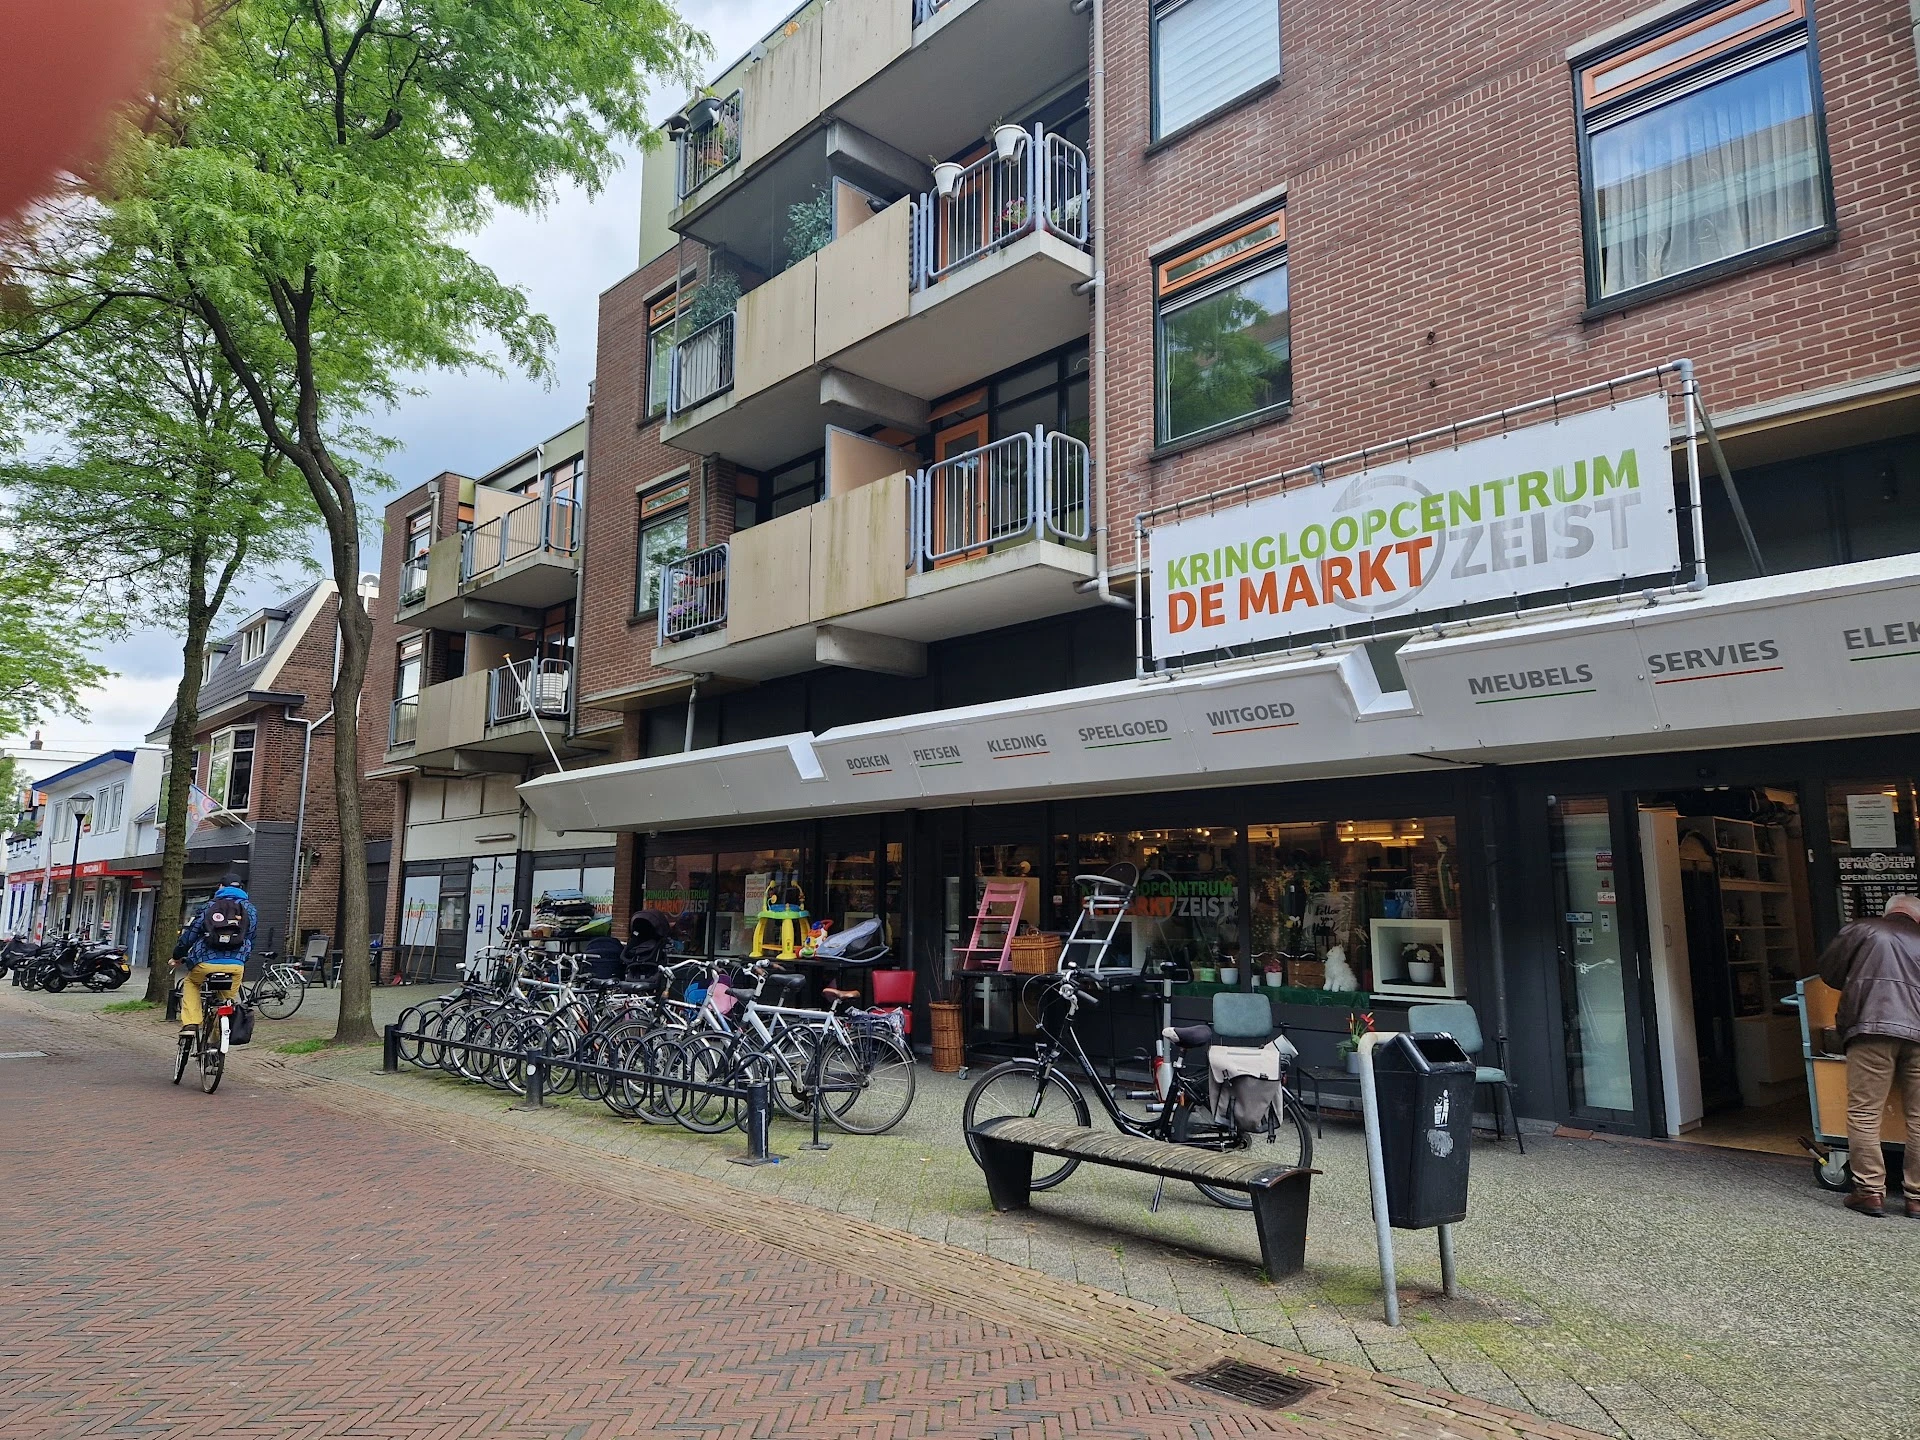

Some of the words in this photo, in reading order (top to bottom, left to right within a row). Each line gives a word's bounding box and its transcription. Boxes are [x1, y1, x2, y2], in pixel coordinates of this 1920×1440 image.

[1167, 448, 1641, 591] KRINGLOOPCENTRUM
[1168, 583, 1226, 634] DE
[1238, 536, 1433, 620] MARKT
[1449, 492, 1642, 580] ZEIST
[1647, 639, 1779, 674] SERVIES
[1468, 664, 1593, 695] MEUBELS
[1206, 702, 1295, 727] WITGOED
[1078, 719, 1169, 742] SPEELGOED
[913, 745, 960, 763] FIETSEN
[987, 733, 1047, 753] KLEDING
[846, 754, 890, 771] BOEKEN
[1889, 861, 1915, 869] ZEIST
[1178, 897, 1235, 917] ZEIST
